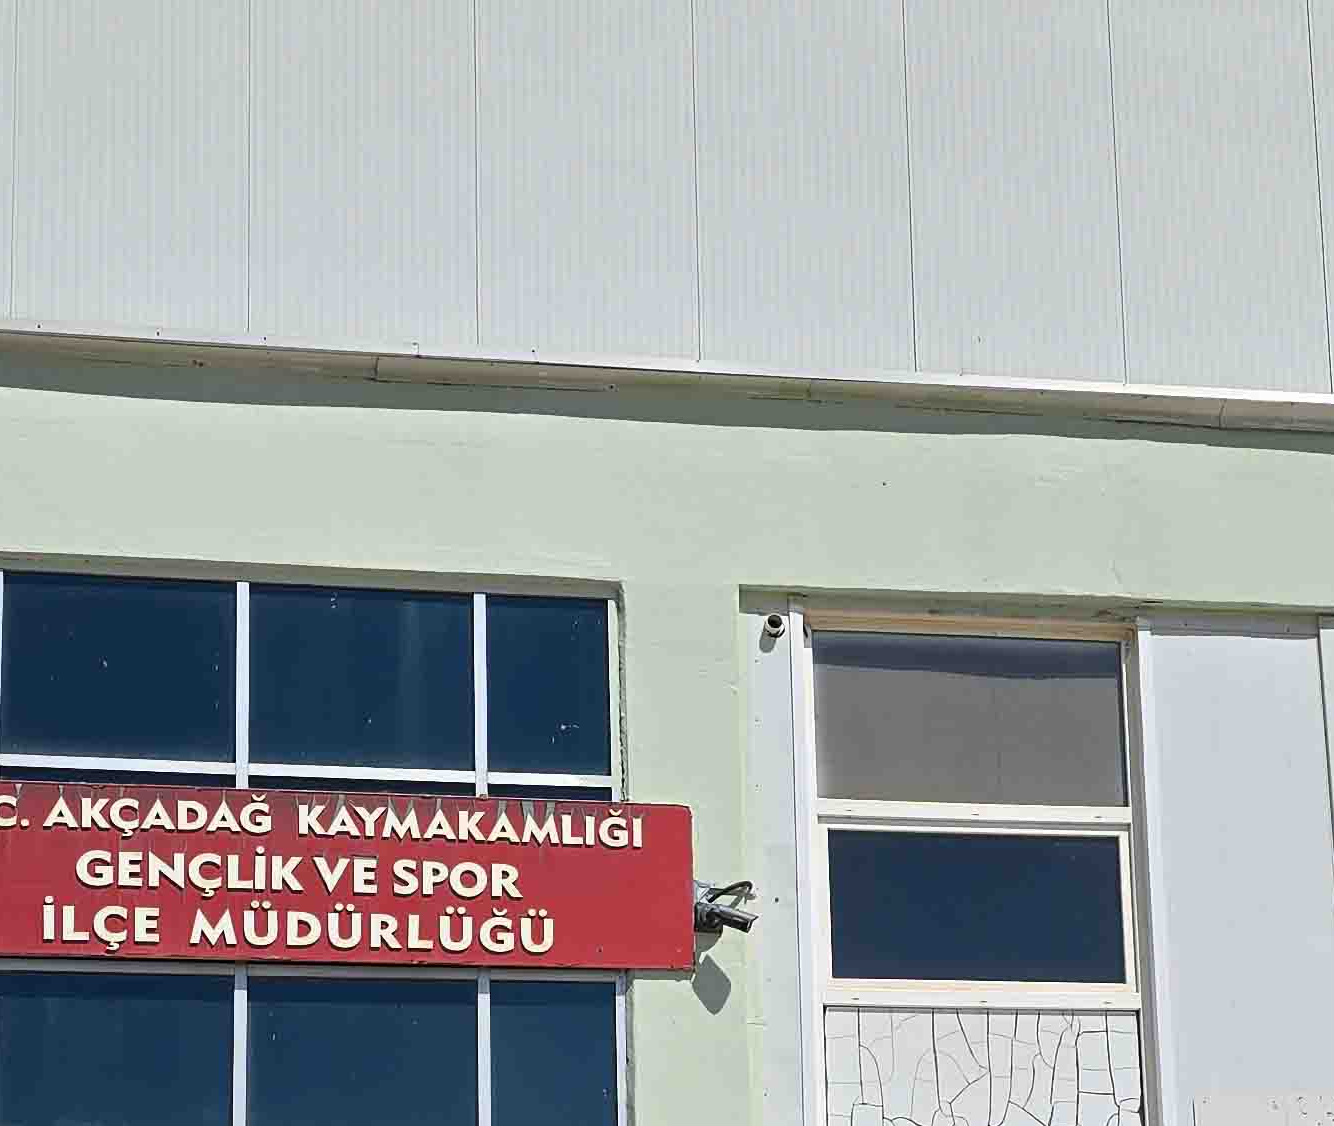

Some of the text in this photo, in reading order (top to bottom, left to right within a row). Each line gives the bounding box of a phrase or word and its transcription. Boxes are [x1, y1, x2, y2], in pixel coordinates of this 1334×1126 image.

[42, 793, 273, 836] AKÇADAĞ
[297, 803, 644, 849] KAYMAKAMLIĞI
[75, 845, 524, 899] GENÇLİK VE SPOR
[41, 895, 556, 955] İLÇE MÜDÜRLÜĞÜ
